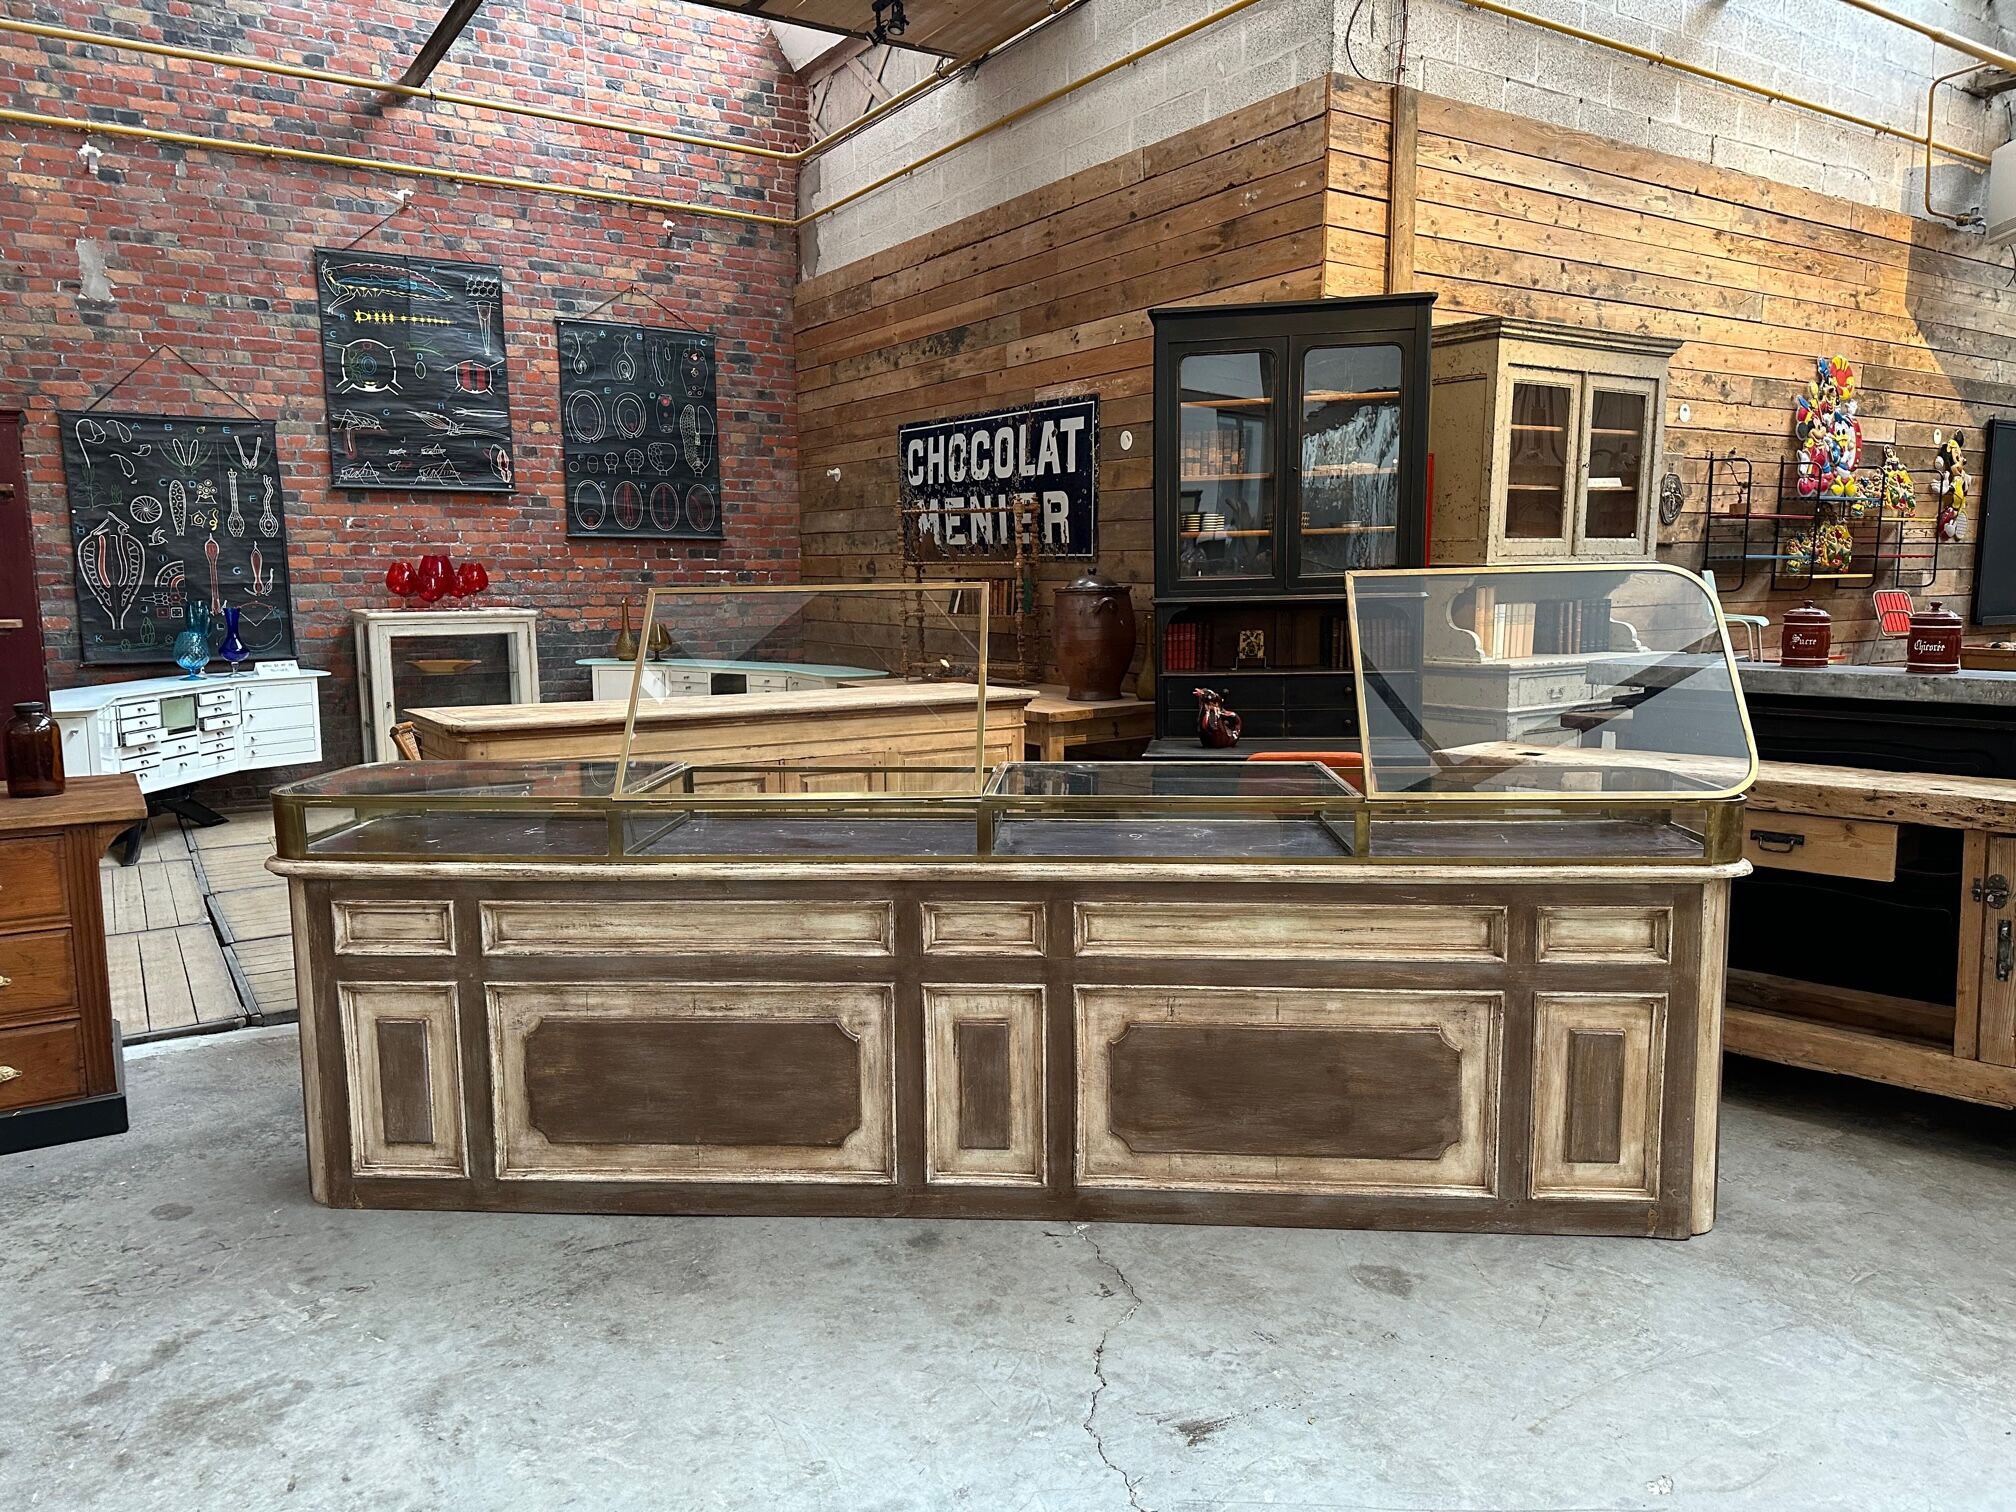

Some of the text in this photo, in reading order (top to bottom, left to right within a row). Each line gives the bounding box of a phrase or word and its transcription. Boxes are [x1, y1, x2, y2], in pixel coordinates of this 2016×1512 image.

[131, 422, 141, 431] A
[164, 423, 173, 431] B
[907, 416, 1085, 486] CHOCOLAT
[158, 478, 168, 487] C
[188, 480, 196, 488] D
[248, 494, 257, 503] F
[916, 490, 1070, 546] MENIER
[76, 526, 85, 534] H
[232, 566, 241, 575] G
[141, 605, 148, 614] J
[95, 634, 103, 643] K
